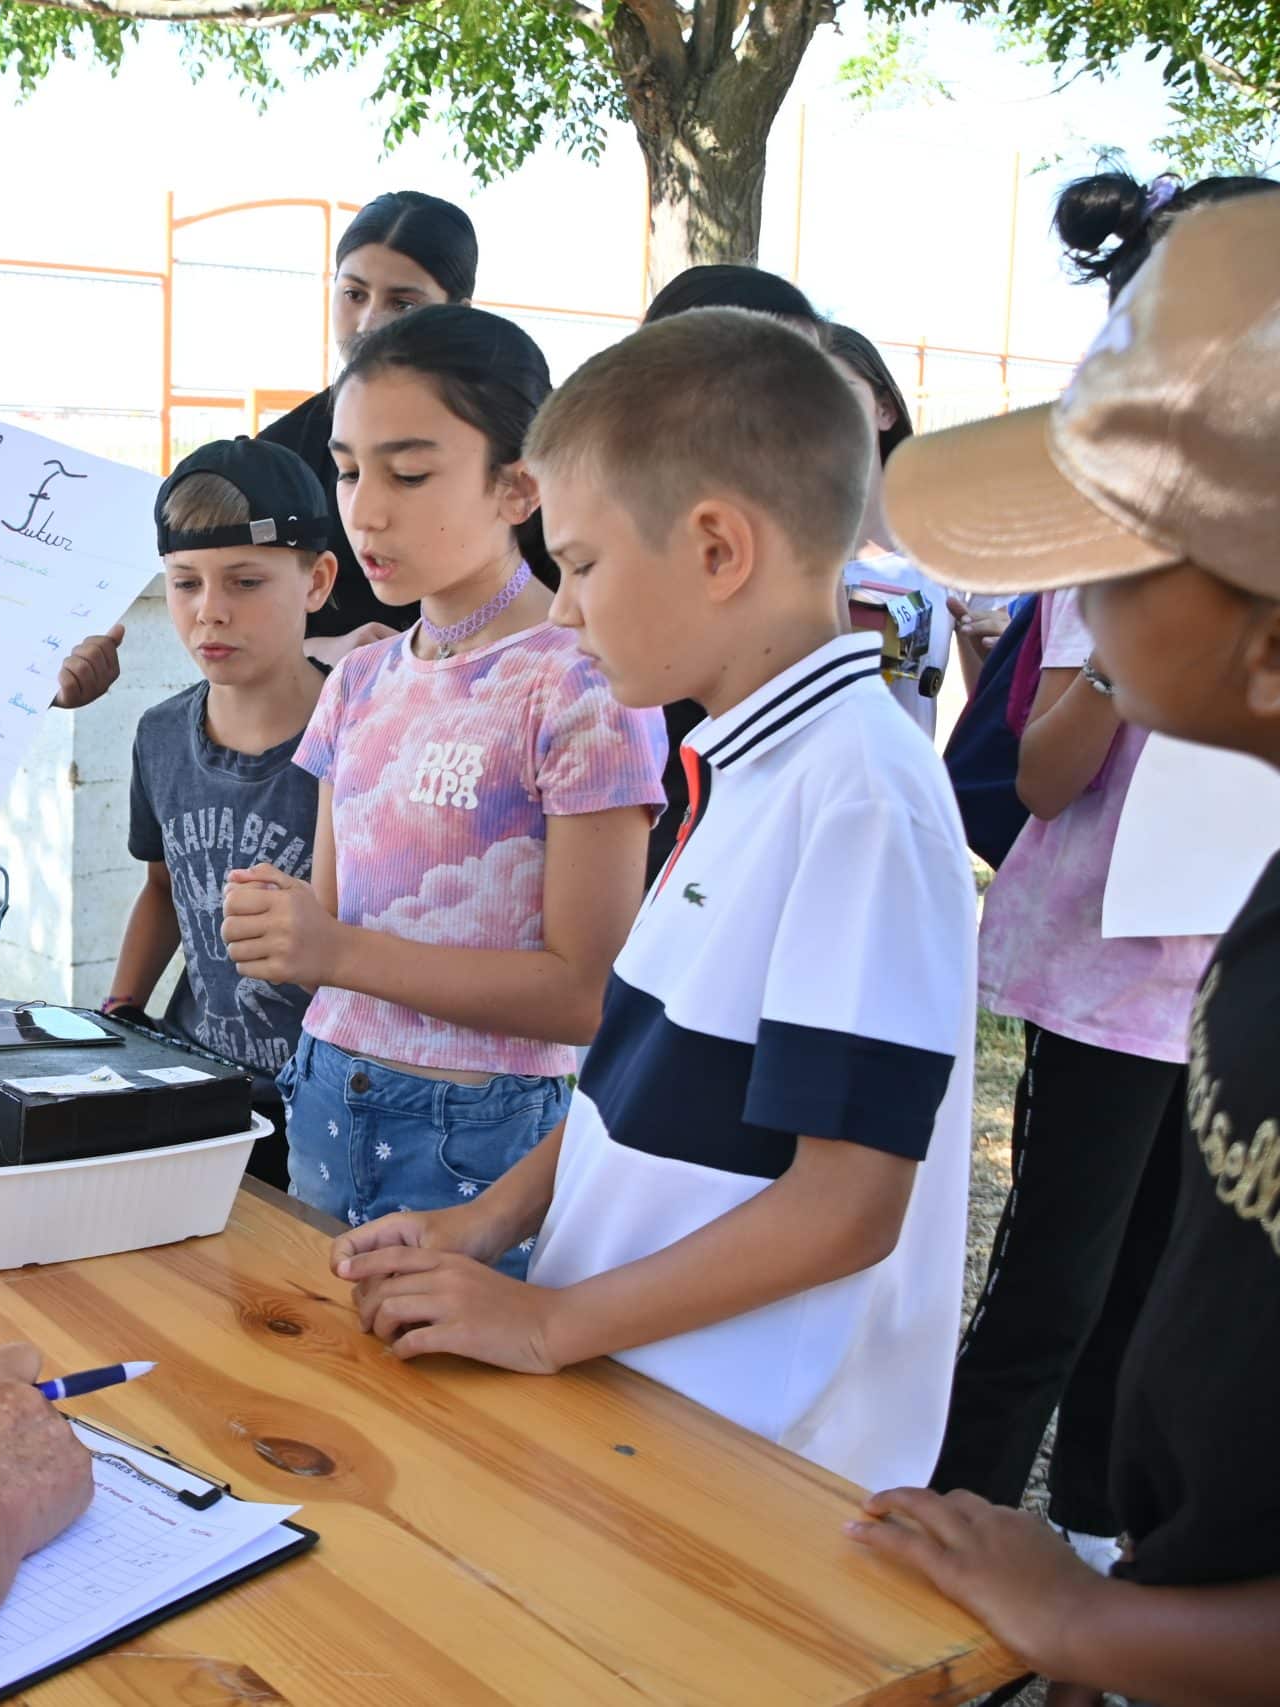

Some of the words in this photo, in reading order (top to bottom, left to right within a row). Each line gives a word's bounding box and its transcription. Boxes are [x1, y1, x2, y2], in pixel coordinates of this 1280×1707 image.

[1, 460, 87, 551] Futur
[897, 606, 912, 625] 16
[420, 742, 484, 777] DUA
[409, 767, 479, 810] LIPA
[161, 807, 235, 857] KAUA
